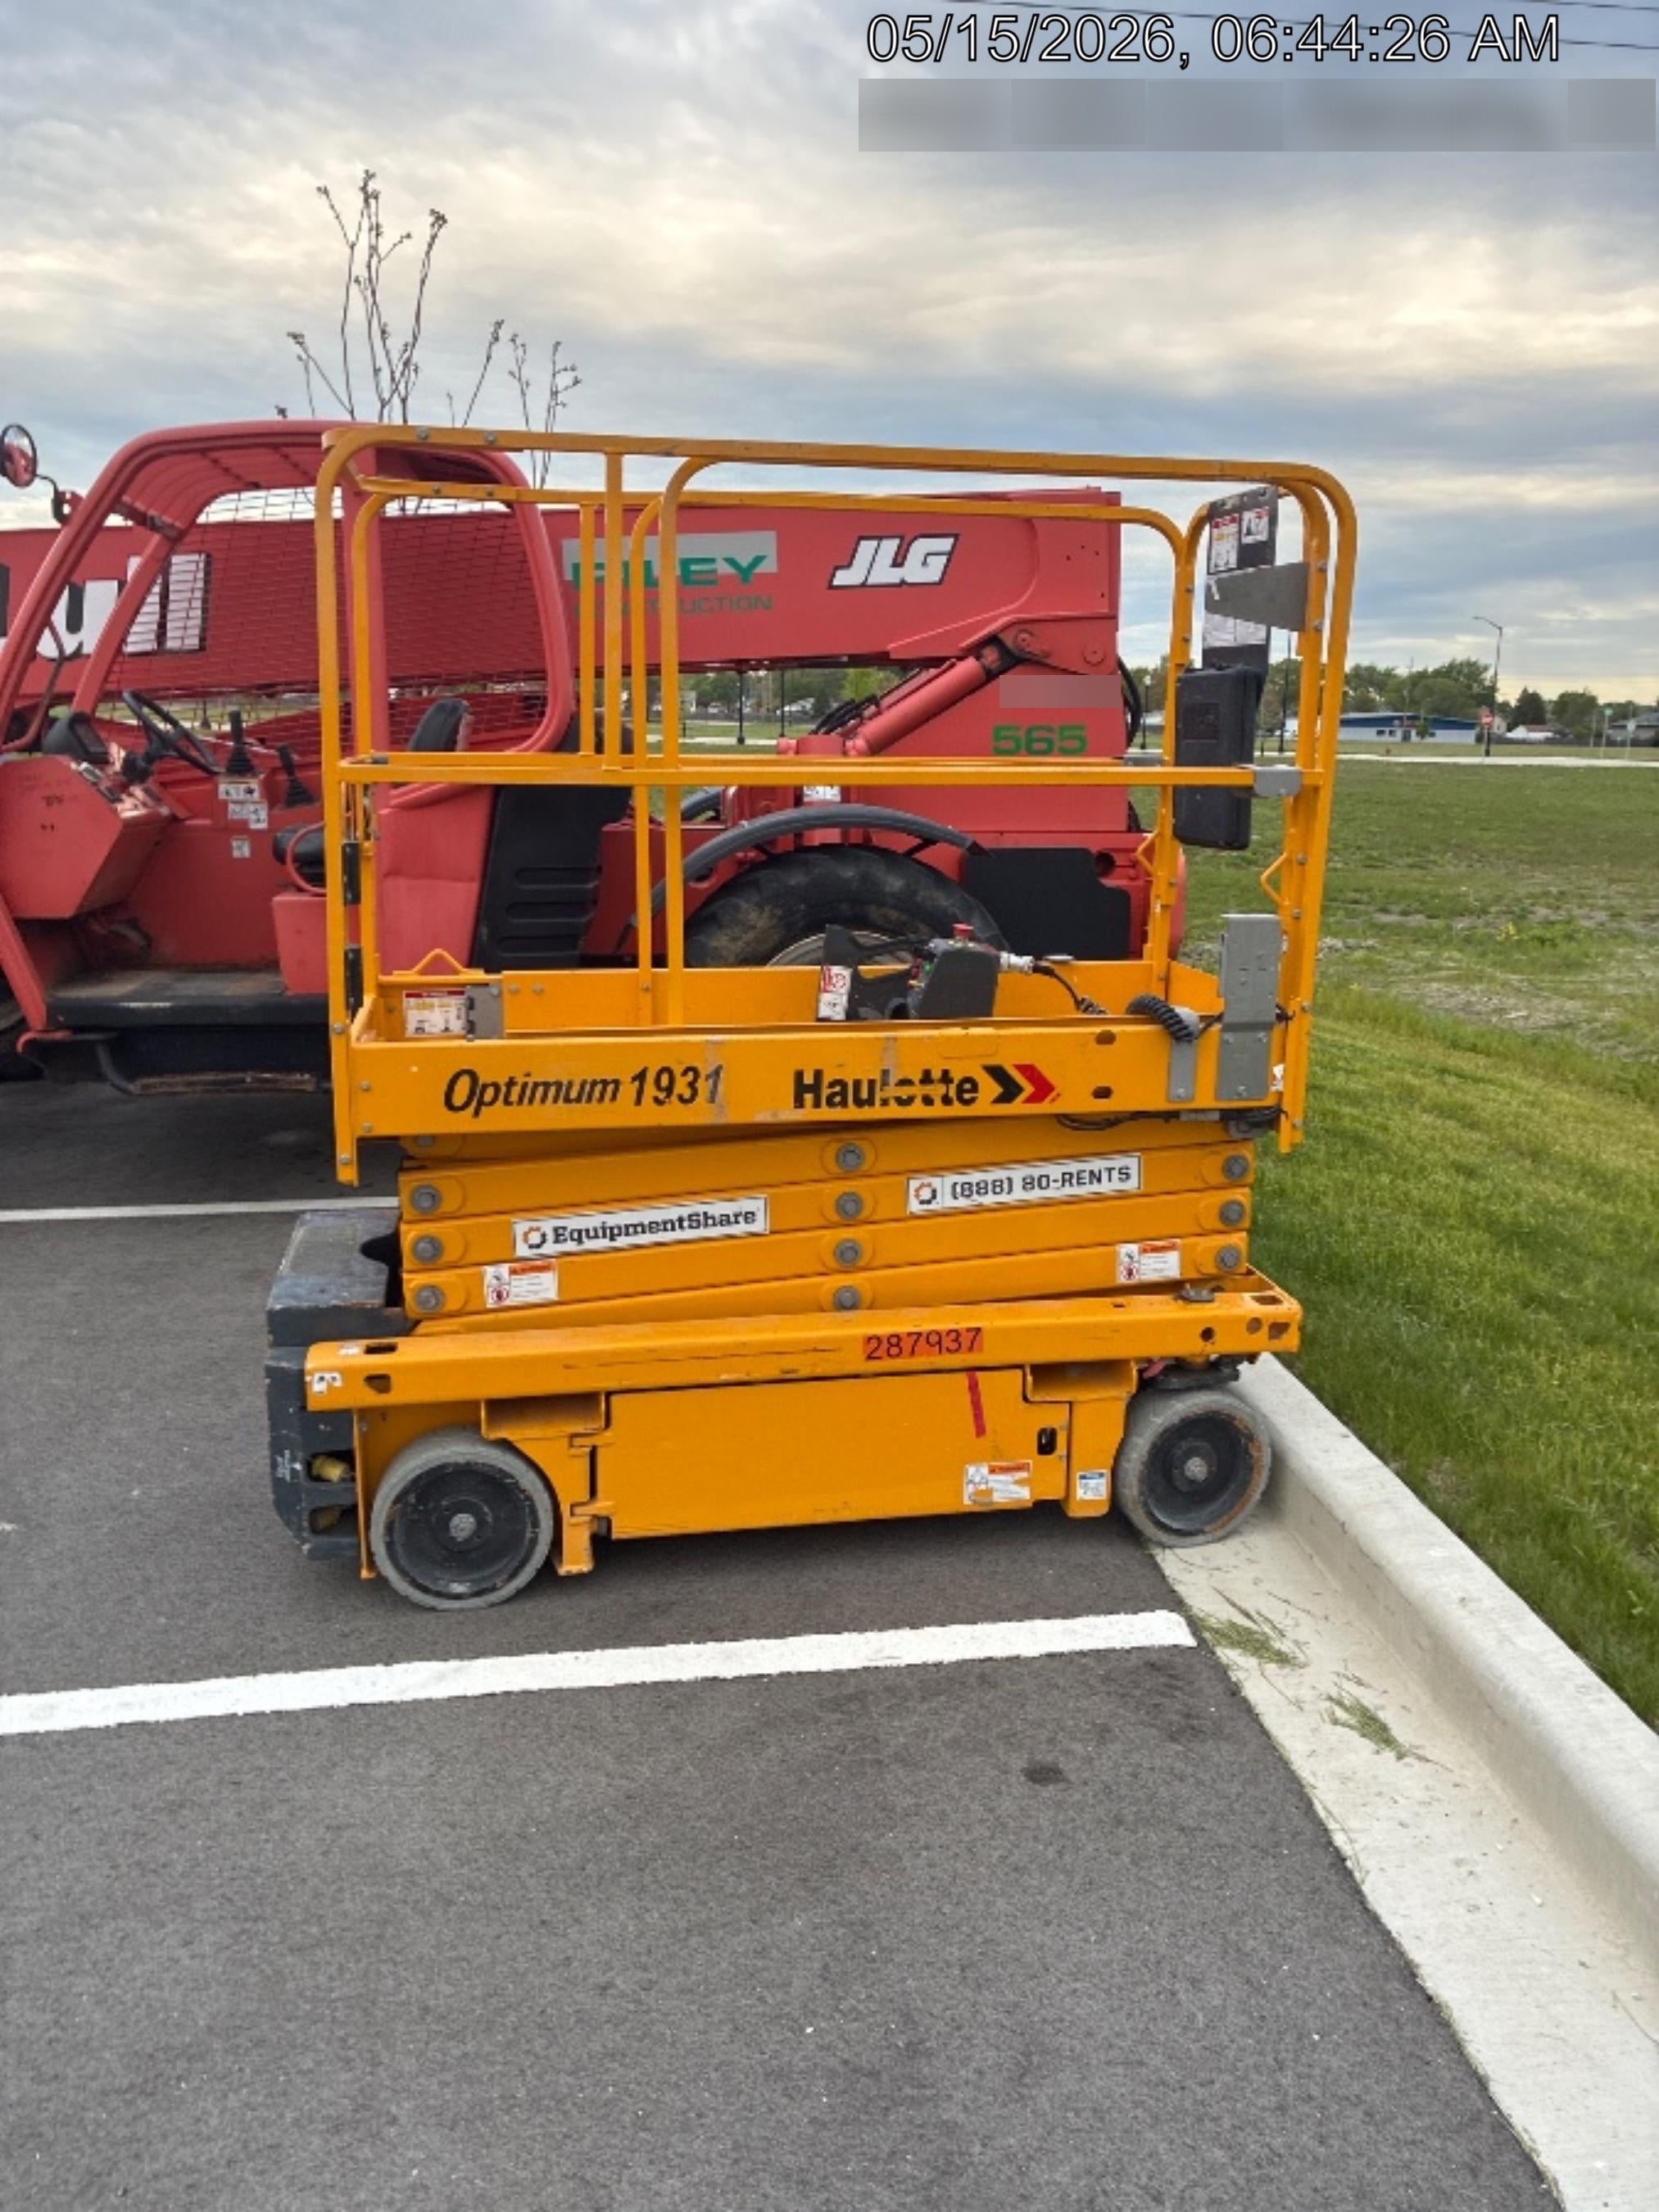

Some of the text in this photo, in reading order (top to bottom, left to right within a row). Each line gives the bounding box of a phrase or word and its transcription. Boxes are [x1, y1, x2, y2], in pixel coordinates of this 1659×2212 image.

[827, 533, 960, 590] JLG
[0, 551, 211, 660] ull
[991, 723, 1088, 757] 565
[443, 1063, 723, 1119] Optimum 1931
[950, 1165, 1131, 1200] (888) 80-RENTS
[551, 1208, 757, 1245] EquipmentShare
[865, 1326, 982, 1361] 287937
